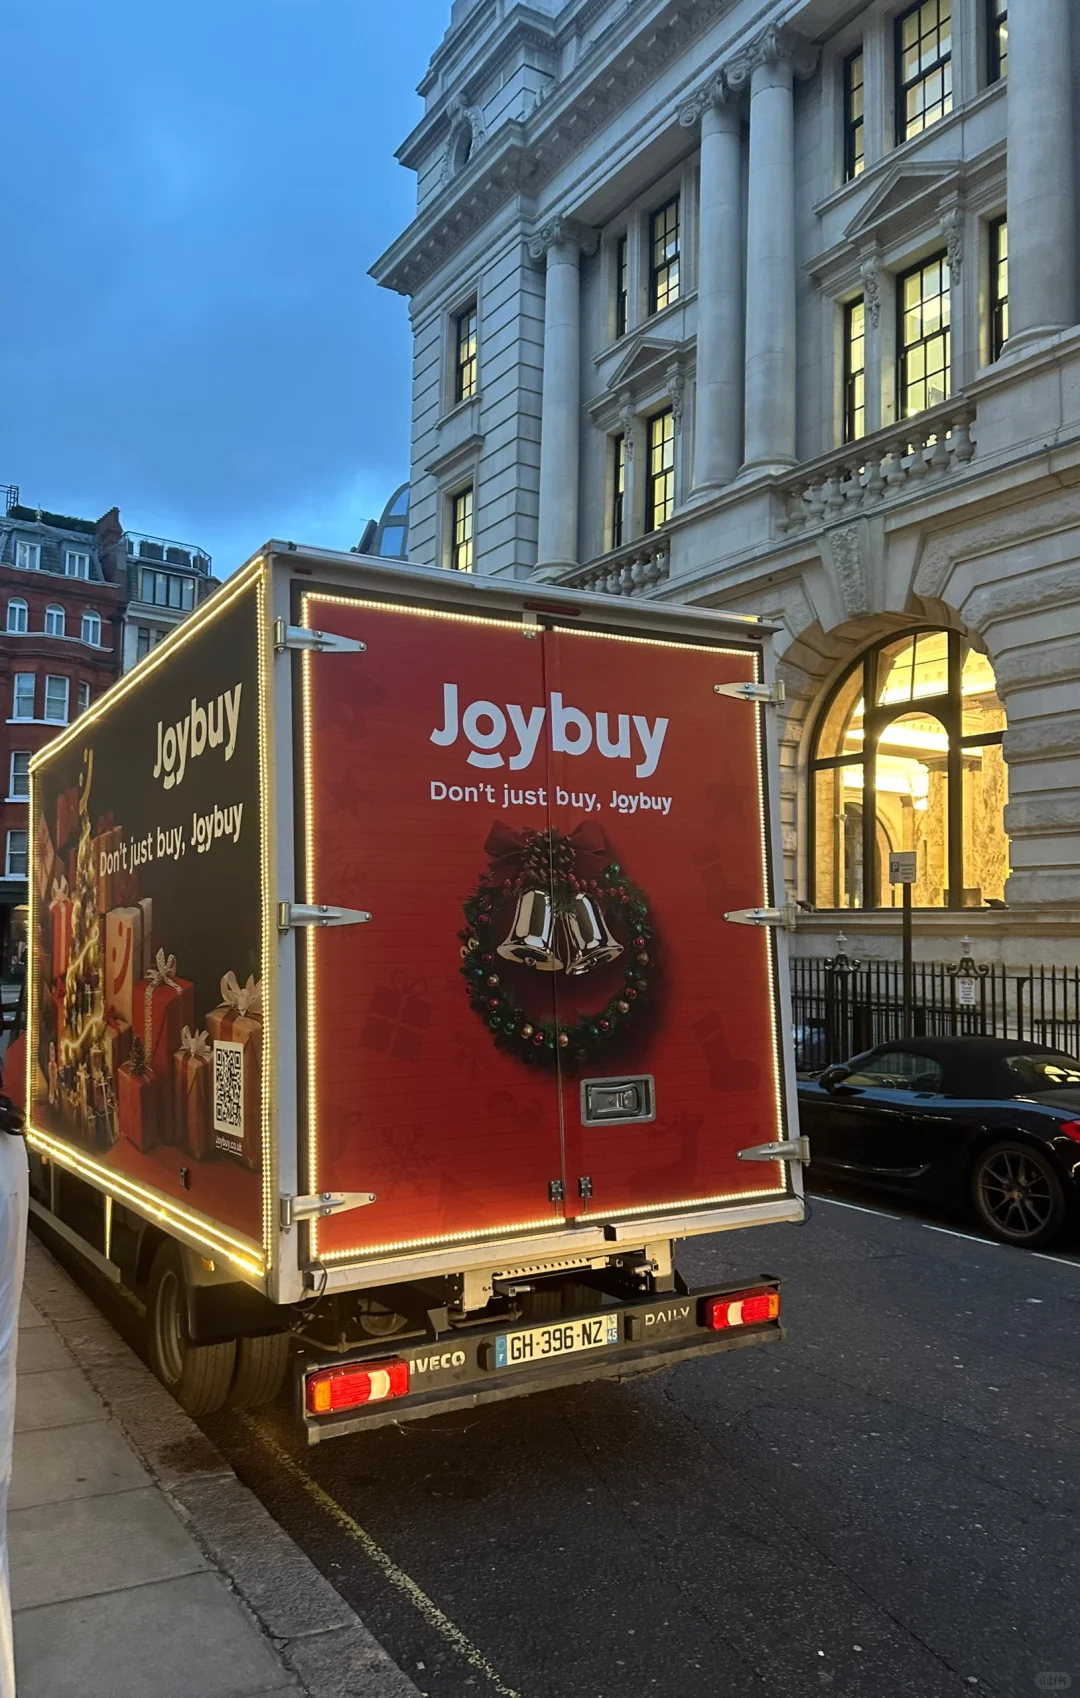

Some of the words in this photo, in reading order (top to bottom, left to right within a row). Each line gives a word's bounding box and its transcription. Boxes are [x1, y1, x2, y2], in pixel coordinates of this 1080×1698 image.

[153, 682, 243, 790] Joybuy
[429, 682, 669, 778] Joybuy
[430, 781, 496, 803] Don't
[502, 784, 547, 809] just
[556, 786, 602, 812] buy,
[609, 790, 672, 816] Joybuy
[100, 842, 127, 877] Don't
[129, 832, 153, 875] just
[157, 825, 186, 861] buy,
[190, 802, 243, 854] Joybuy
[645, 1306, 690, 1326] DAILY
[511, 1320, 603, 1360] GH-396-NZ
[607, 1328, 617, 1341] 45
[409, 1350, 466, 1375] IVECO
[499, 1353, 504, 1362] F
